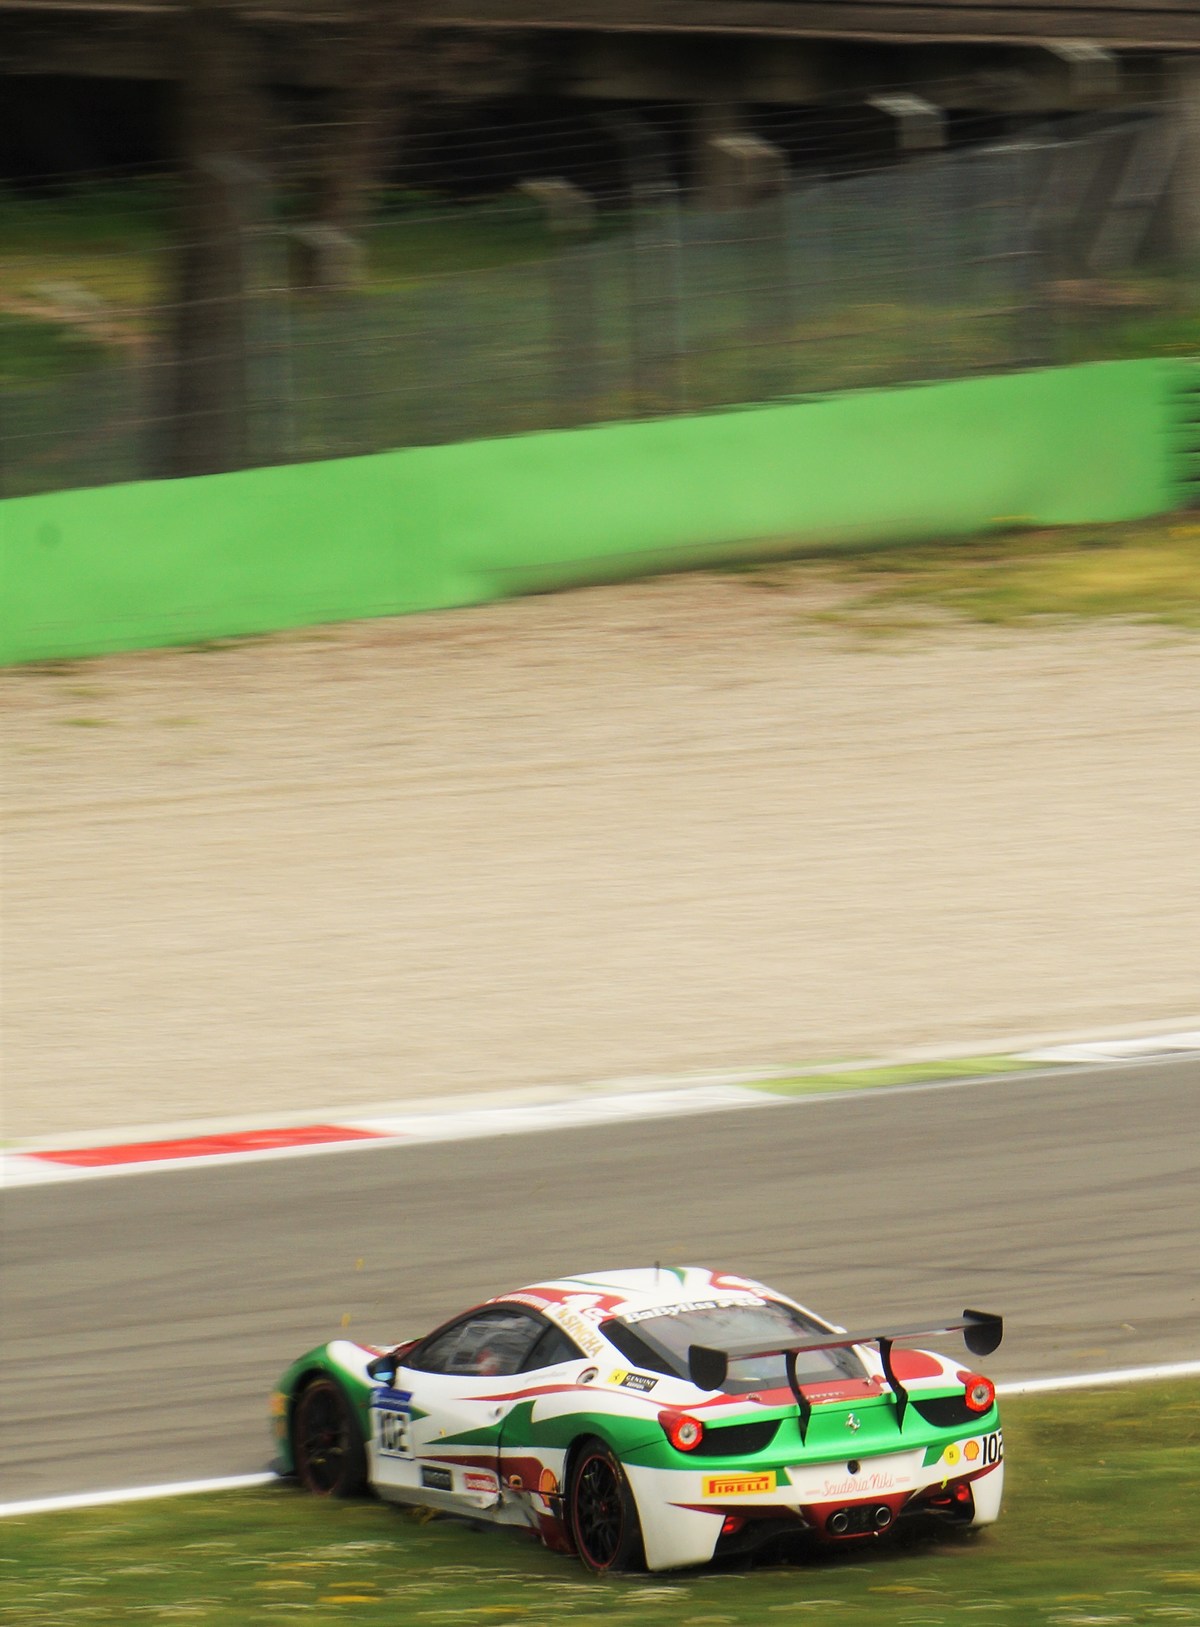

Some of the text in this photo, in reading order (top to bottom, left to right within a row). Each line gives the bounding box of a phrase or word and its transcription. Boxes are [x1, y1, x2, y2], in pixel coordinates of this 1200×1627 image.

[626, 1374, 656, 1387] GENUINE
[708, 1476, 769, 1495] PIRELLI
[869, 1472, 894, 1489] Niki
